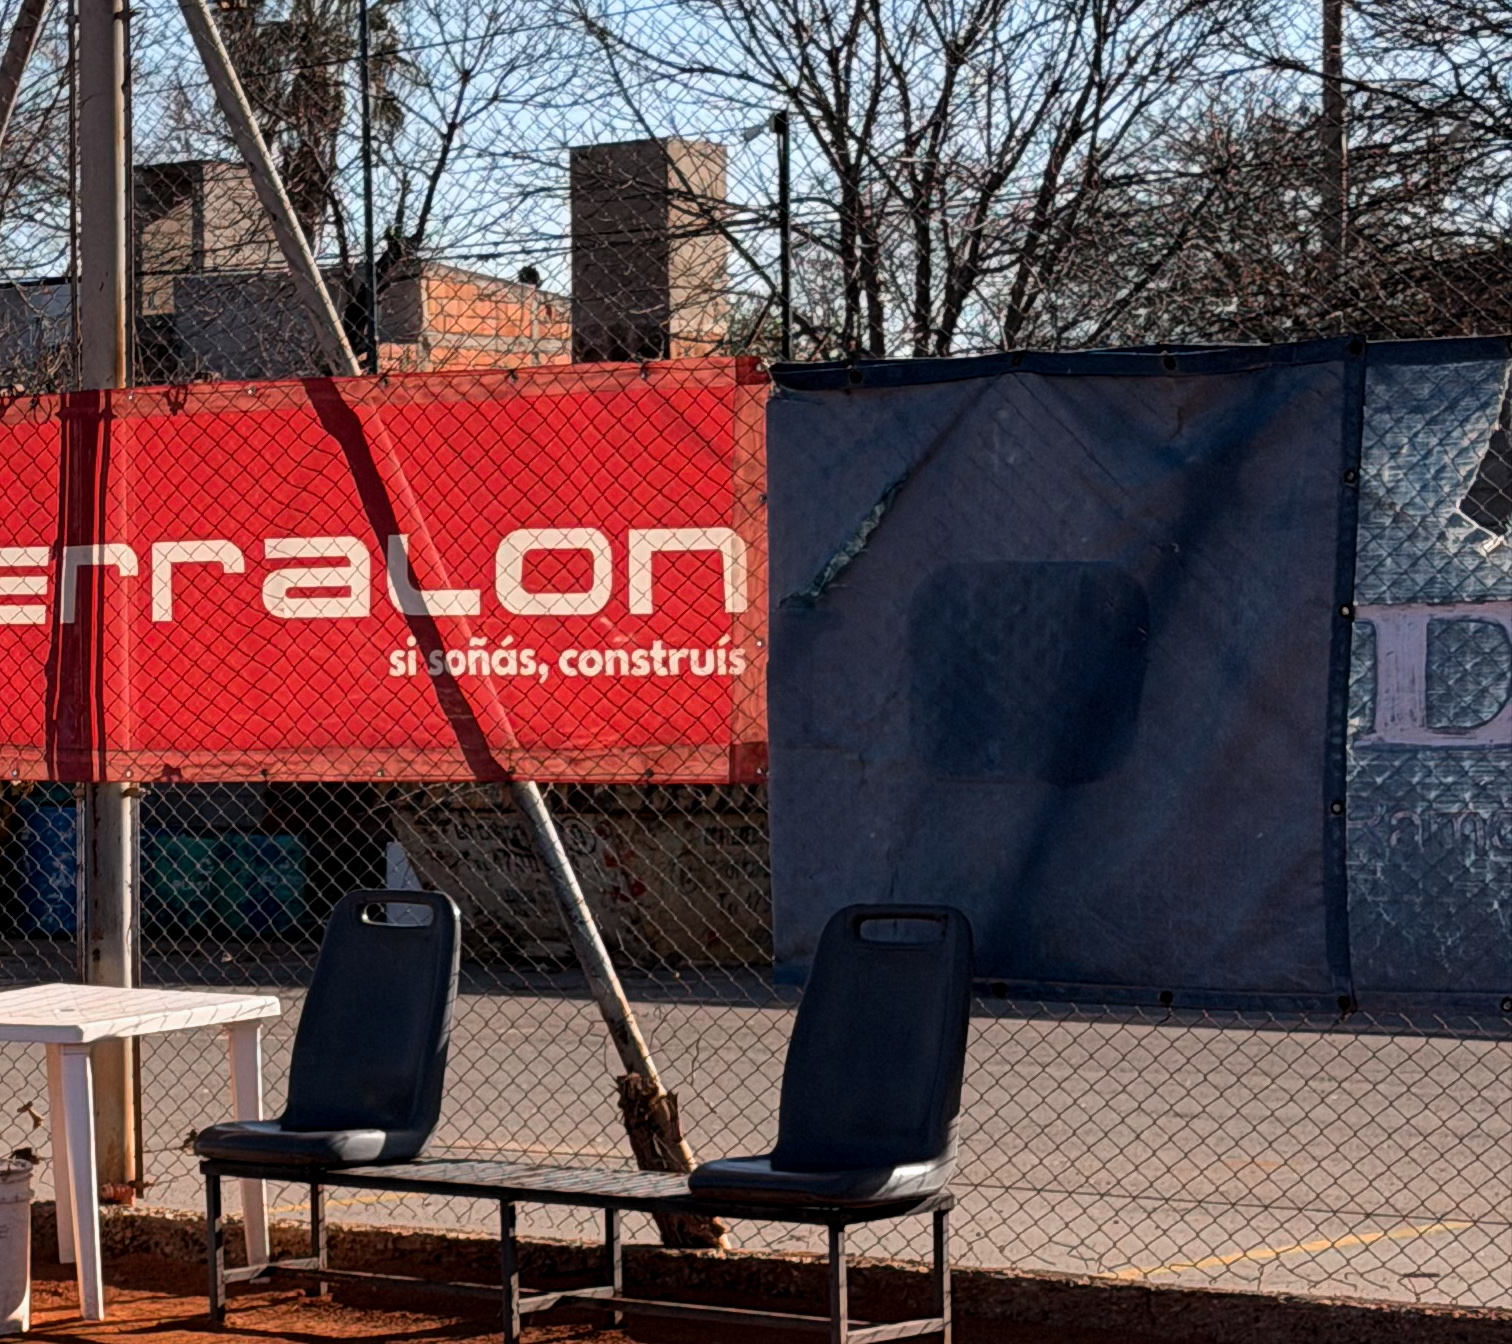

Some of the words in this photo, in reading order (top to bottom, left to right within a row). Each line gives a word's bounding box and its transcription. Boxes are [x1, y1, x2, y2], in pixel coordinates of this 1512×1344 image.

[389, 635, 417, 678] si
[428, 634, 551, 685] soñás,
[558, 632, 748, 678] construís
